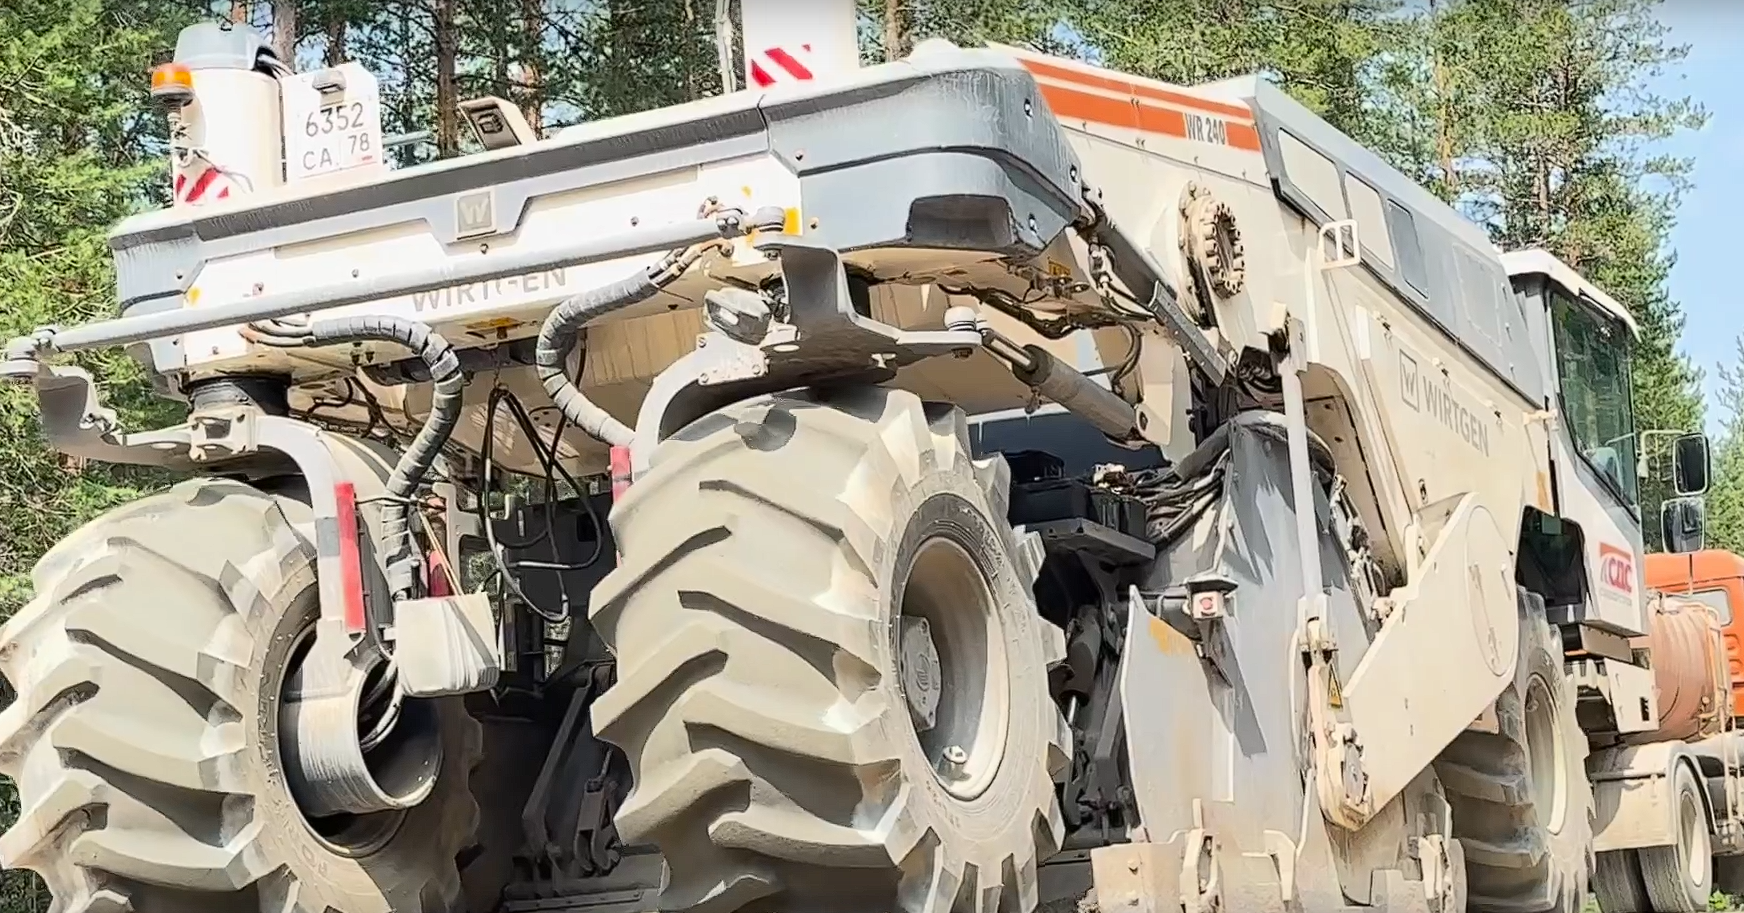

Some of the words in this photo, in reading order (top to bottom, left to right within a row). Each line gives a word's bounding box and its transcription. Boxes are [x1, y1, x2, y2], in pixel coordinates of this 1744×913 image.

[305, 101, 364, 138] 6352
[1184, 112, 1205, 142] WR
[1205, 116, 1226, 146] 240
[347, 132, 370, 155] 78
[1422, 375, 1490, 458] WIRTGEN
